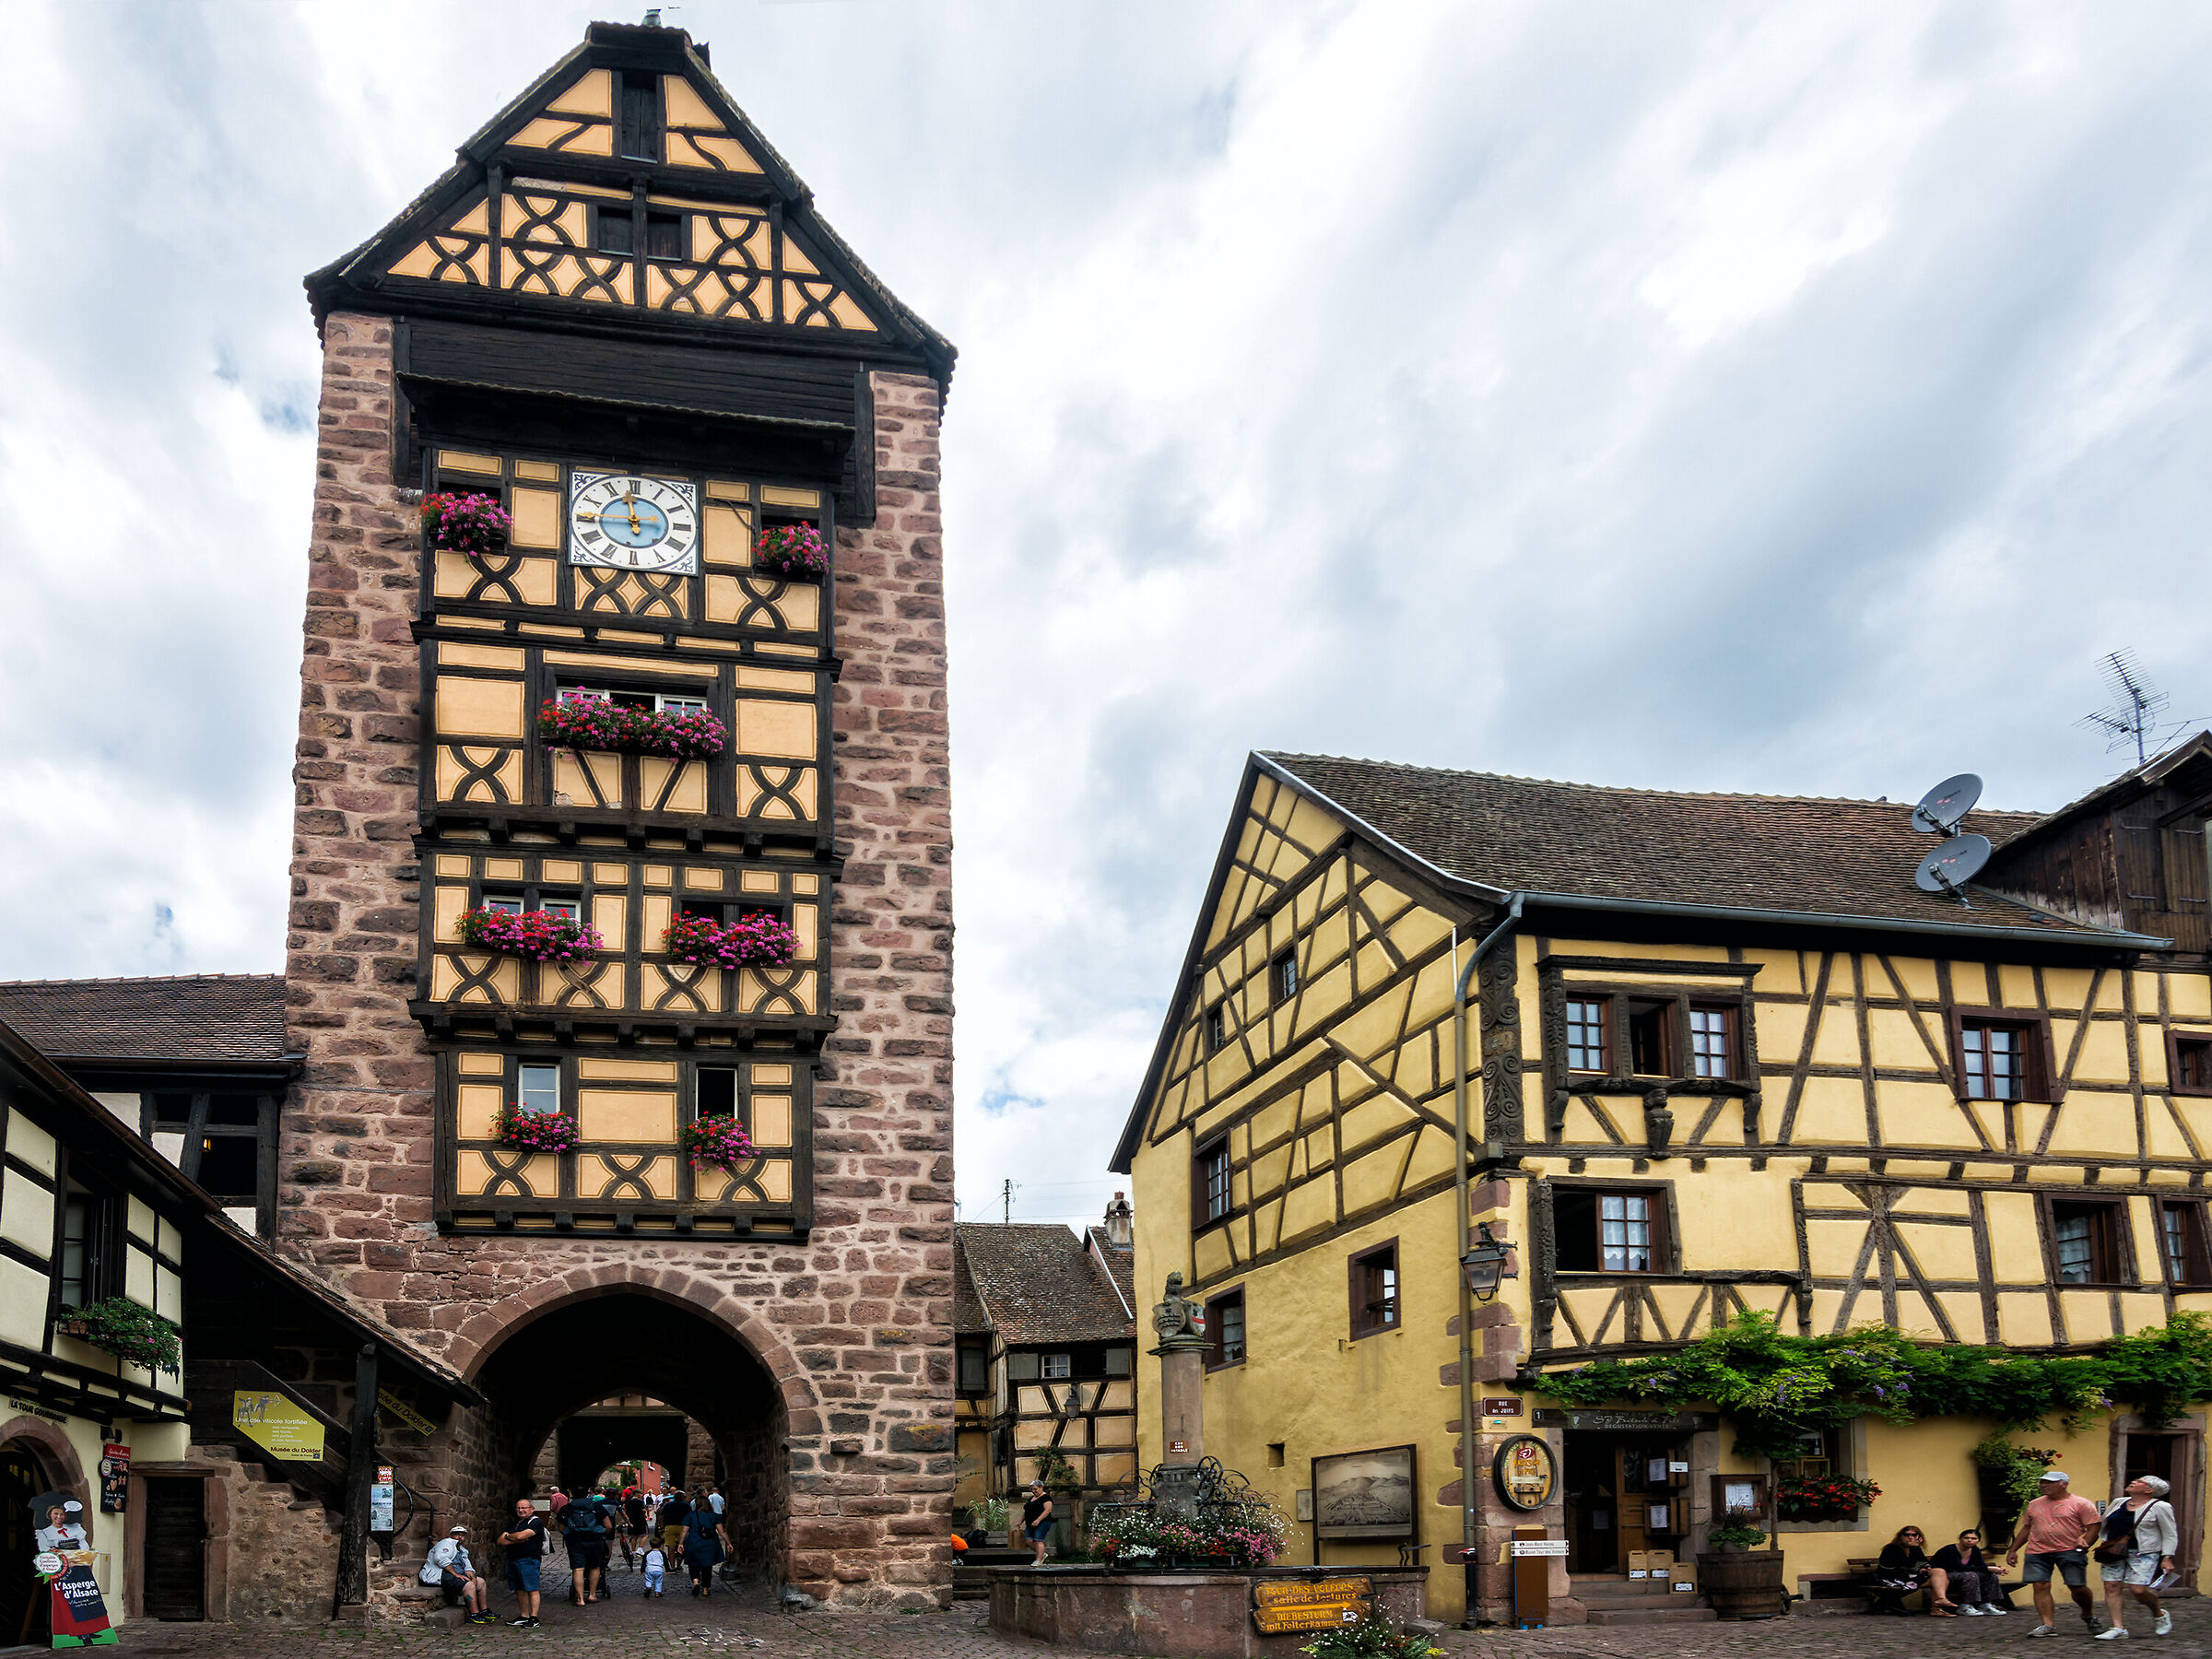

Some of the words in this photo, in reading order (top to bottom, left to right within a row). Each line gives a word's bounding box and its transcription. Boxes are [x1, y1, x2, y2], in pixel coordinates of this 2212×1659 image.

[601, 482, 620, 498] XI
[628, 480, 641, 496] XII
[582, 495, 603, 509] X
[666, 504, 685, 514] II
[673, 523, 691, 532] III
[629, 550, 640, 565] VI
[653, 548, 666, 563] V
[11, 1400, 18, 1409] LA
[18, 1402, 34, 1414] TOUR
[378, 1393, 393, 1405] sée
[392, 1404, 403, 1412] du
[402, 1410, 428, 1429] Dolder
[1535, 1411, 1541, 1419] 1
[53, 1580, 96, 1591] L'Asperge
[1265, 1586, 1289, 1596] TOUR
[1291, 1584, 1310, 1594] DES
[1313, 1583, 1354, 1593] VOLEURS
[64, 1588, 99, 1599] d'Alsace
[1273, 1595, 1300, 1605] salle
[1300, 1594, 1313, 1603] de
[1316, 1592, 1357, 1602] tortures
[1276, 1609, 1334, 1621] DIEBESTURM
